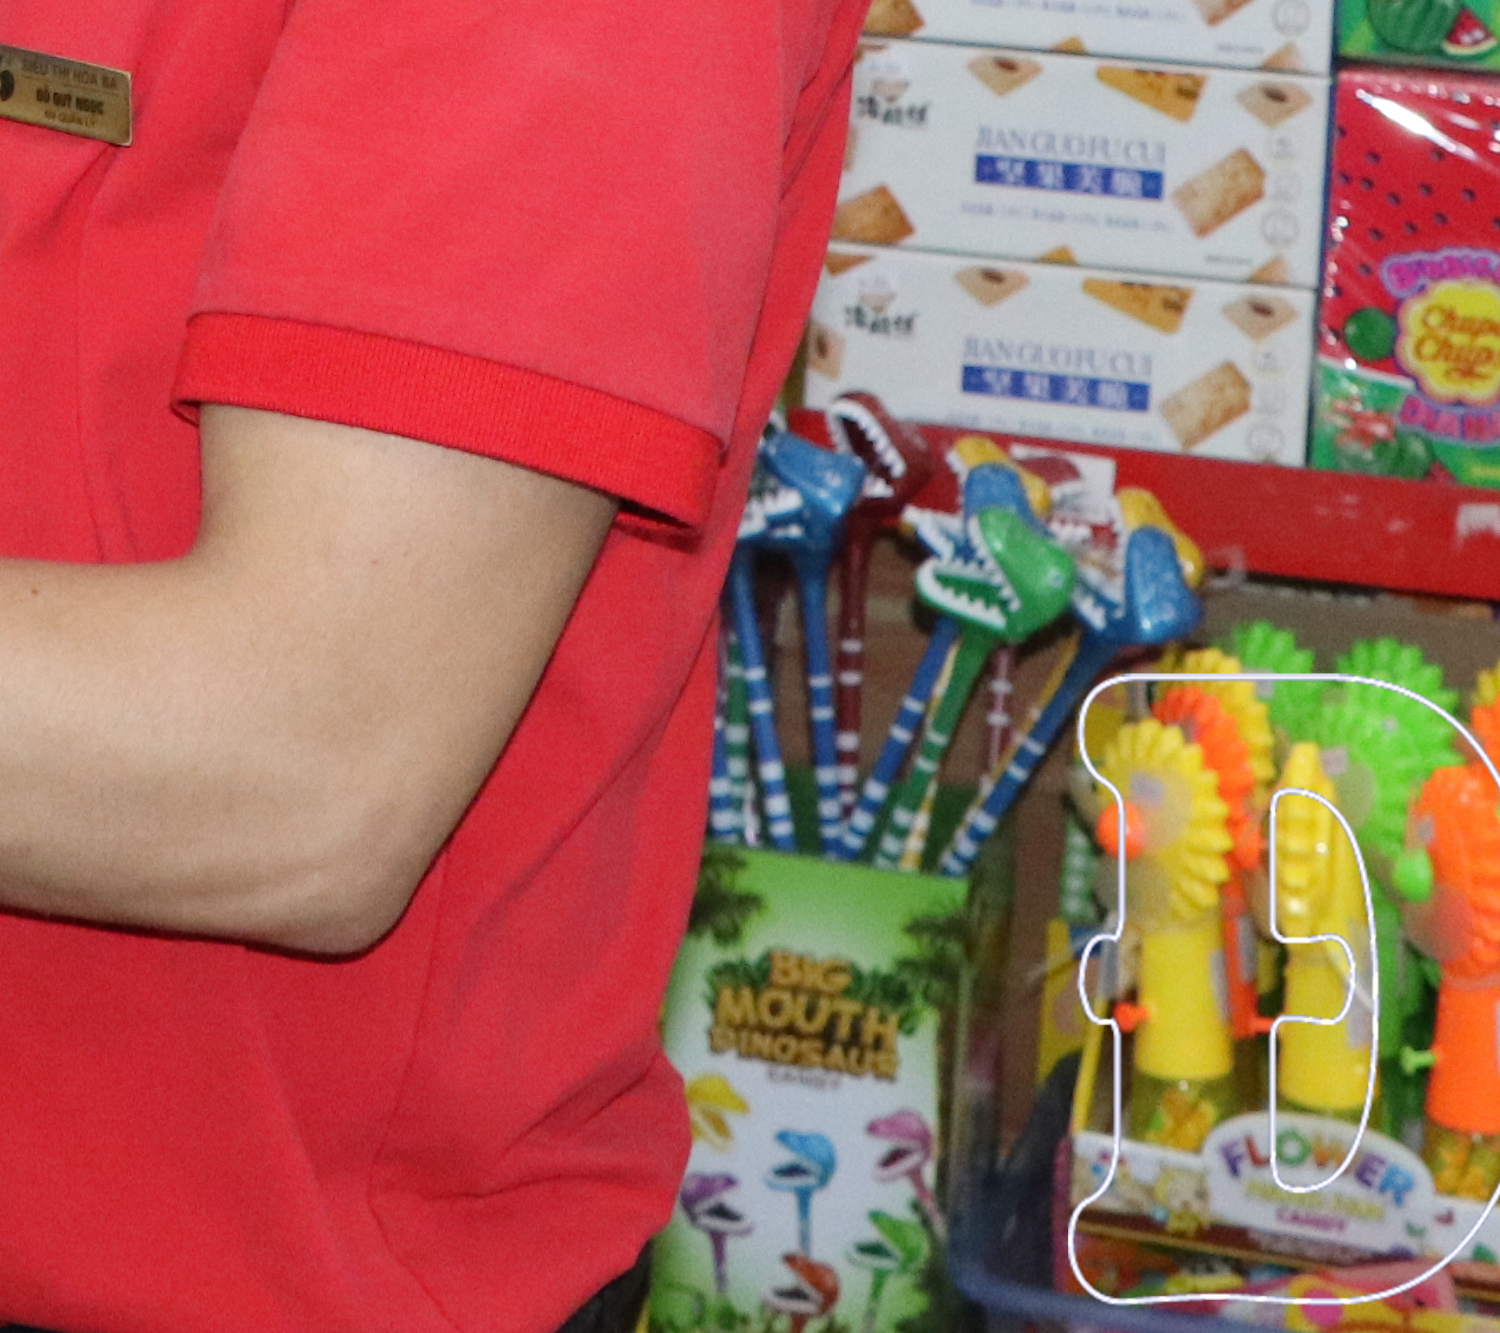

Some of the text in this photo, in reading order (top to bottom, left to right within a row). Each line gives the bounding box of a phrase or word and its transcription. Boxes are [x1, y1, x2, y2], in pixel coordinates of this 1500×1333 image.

[769, 949, 852, 997] BIG
[714, 986, 900, 1053] MOUTH
[709, 1023, 900, 1082] DINOSAUR
[1218, 1130, 1416, 1207] FLOWER
[1275, 1206, 1348, 1234] CANDY
